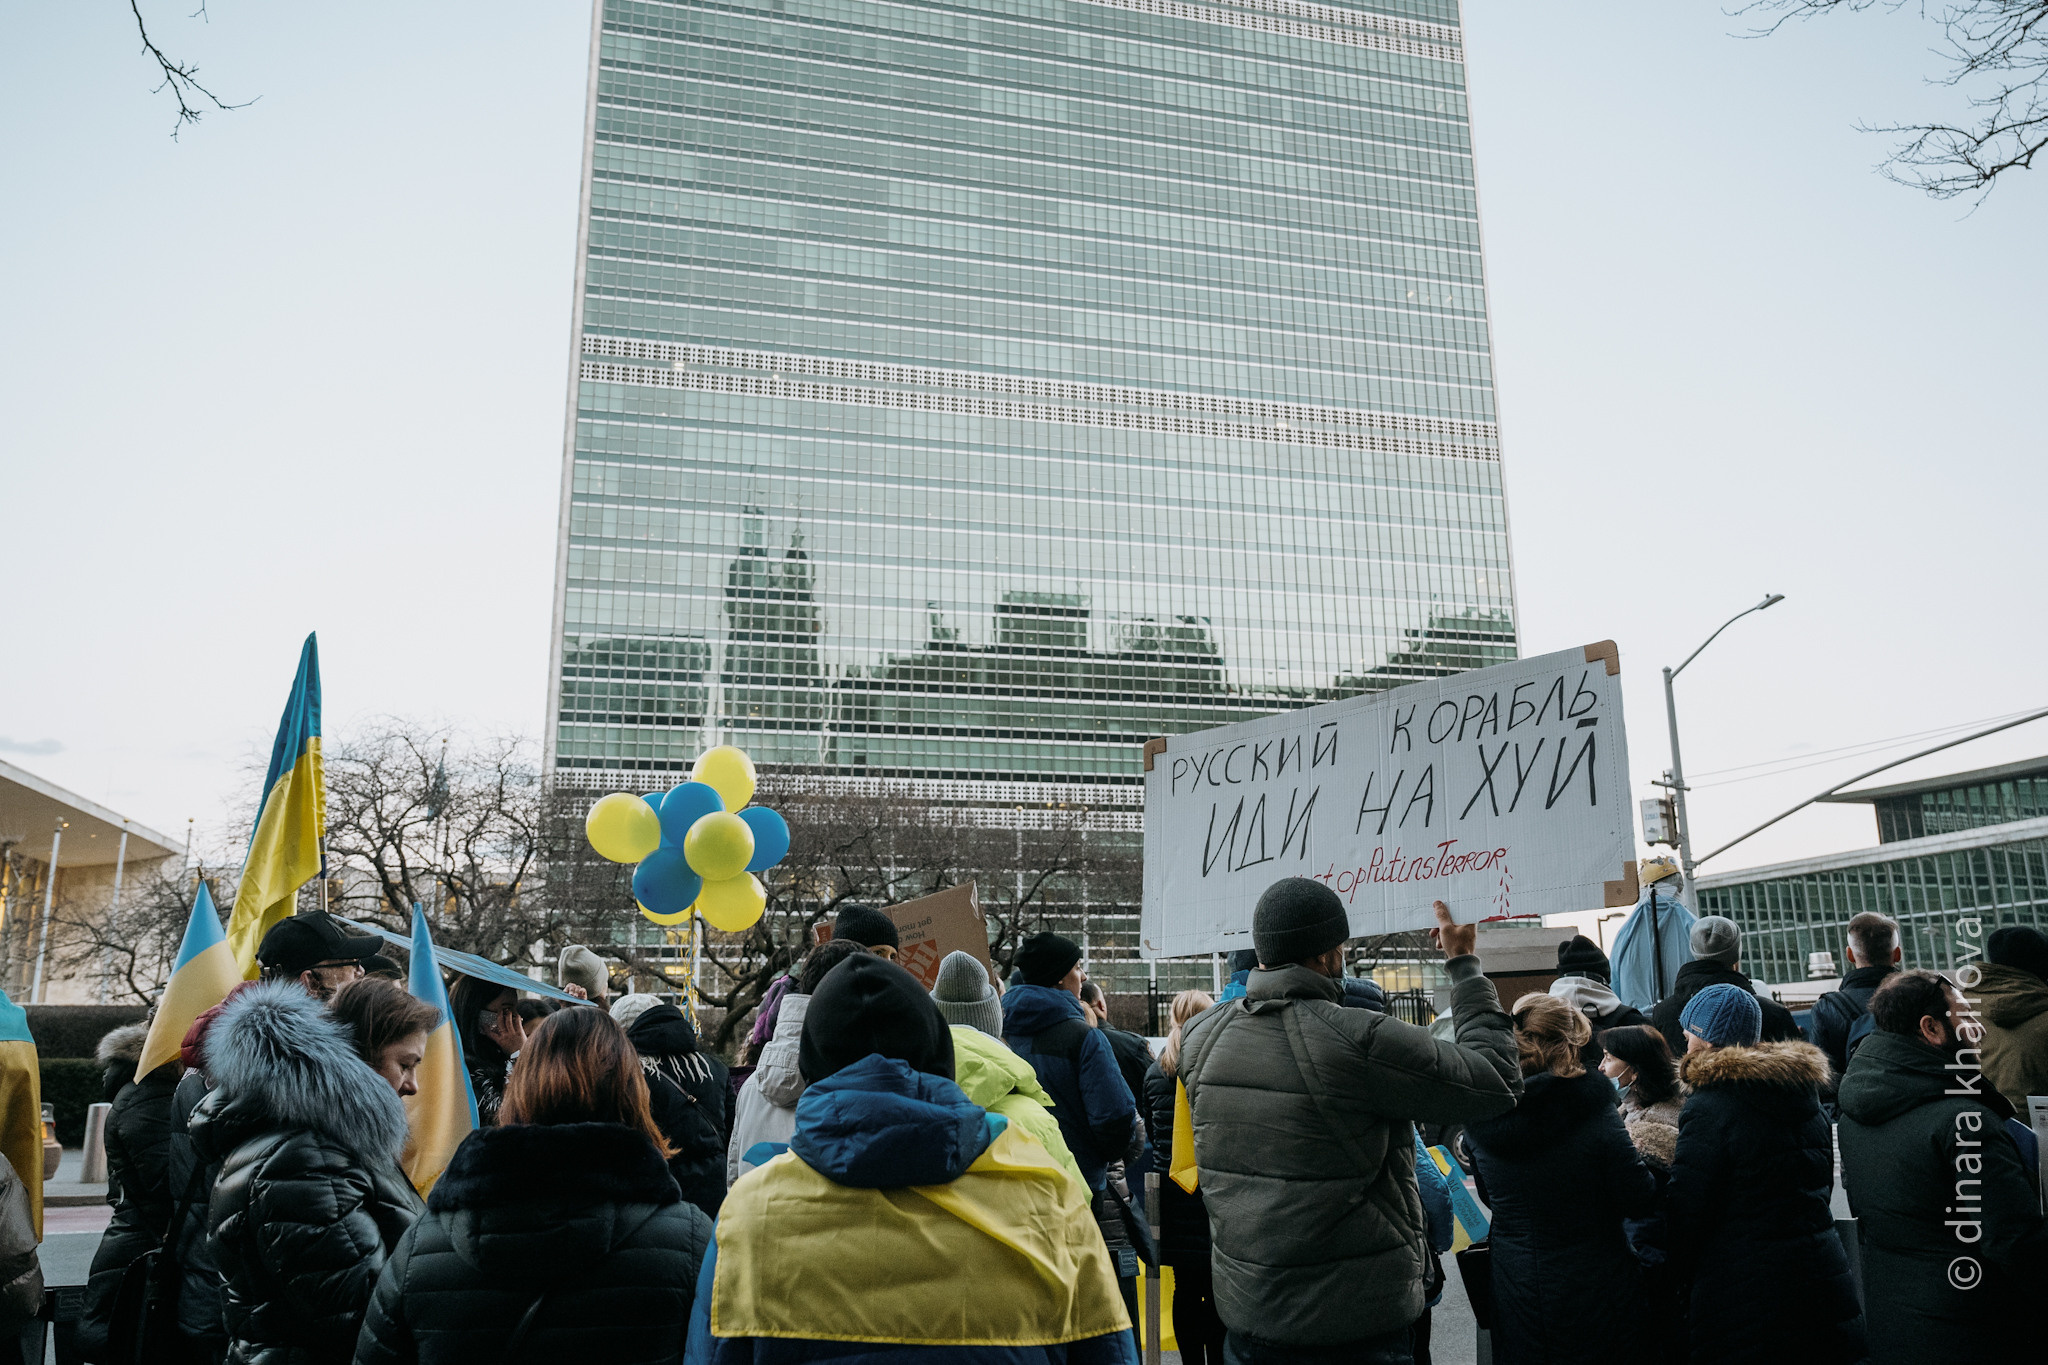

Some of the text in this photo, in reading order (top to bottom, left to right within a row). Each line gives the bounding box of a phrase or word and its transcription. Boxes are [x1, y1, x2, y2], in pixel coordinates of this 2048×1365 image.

[1172, 670, 1598, 798] РУССКИЙ КОРАБЛЬ
[1202, 716, 1600, 878] ИДИ НА ХУЙ
[897, 922, 916, 933] mor
